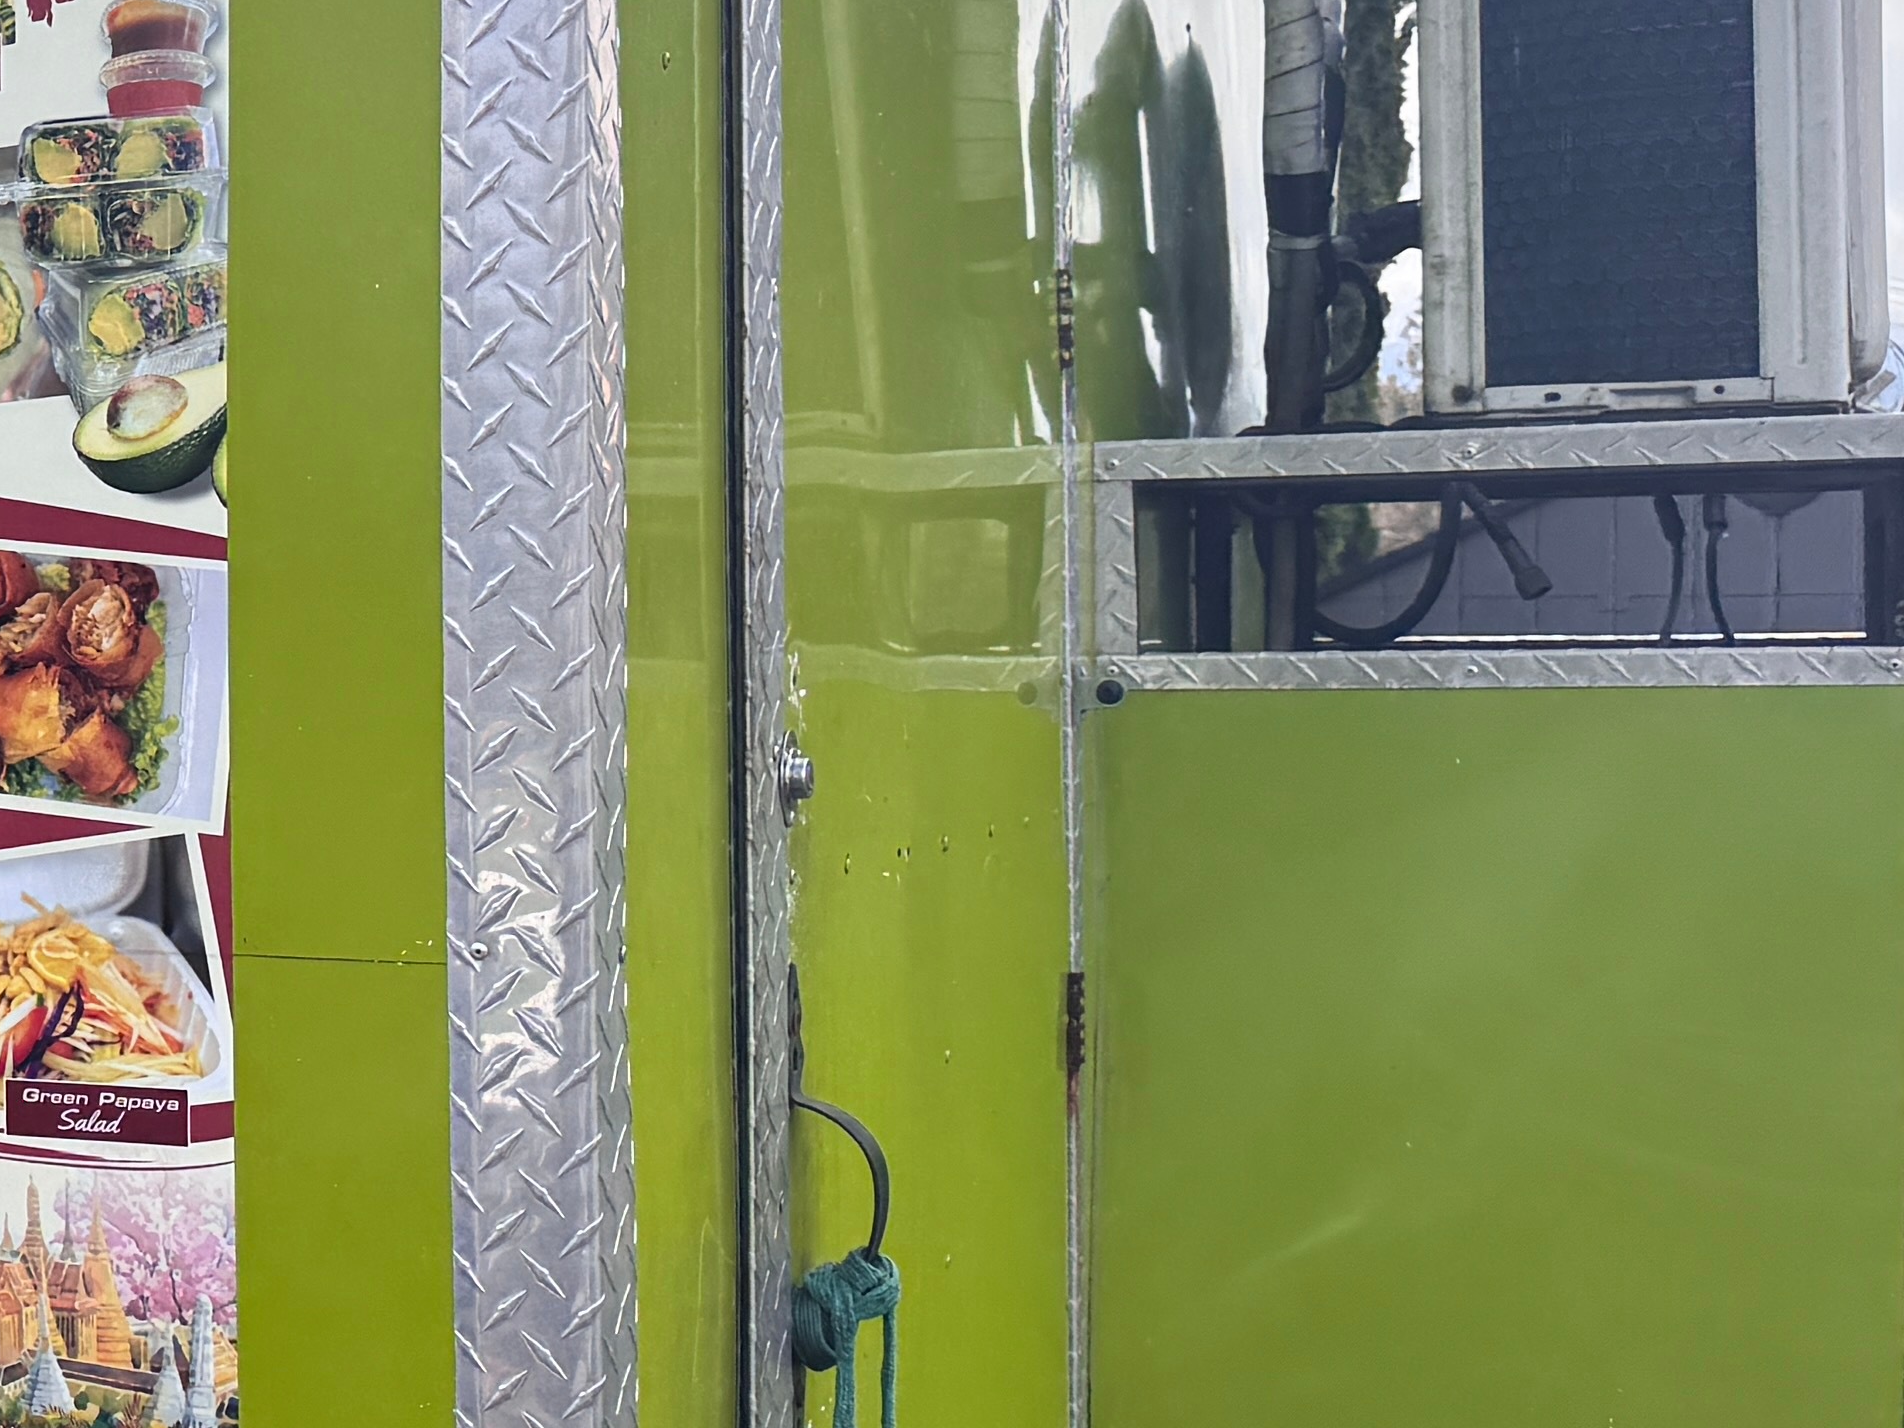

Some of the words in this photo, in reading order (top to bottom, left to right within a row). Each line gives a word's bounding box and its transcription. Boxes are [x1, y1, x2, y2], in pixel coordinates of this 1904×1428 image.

[22, 1088, 88, 1107] Green
[97, 1092, 180, 1112] Papaya
[56, 1110, 123, 1134] Salad
